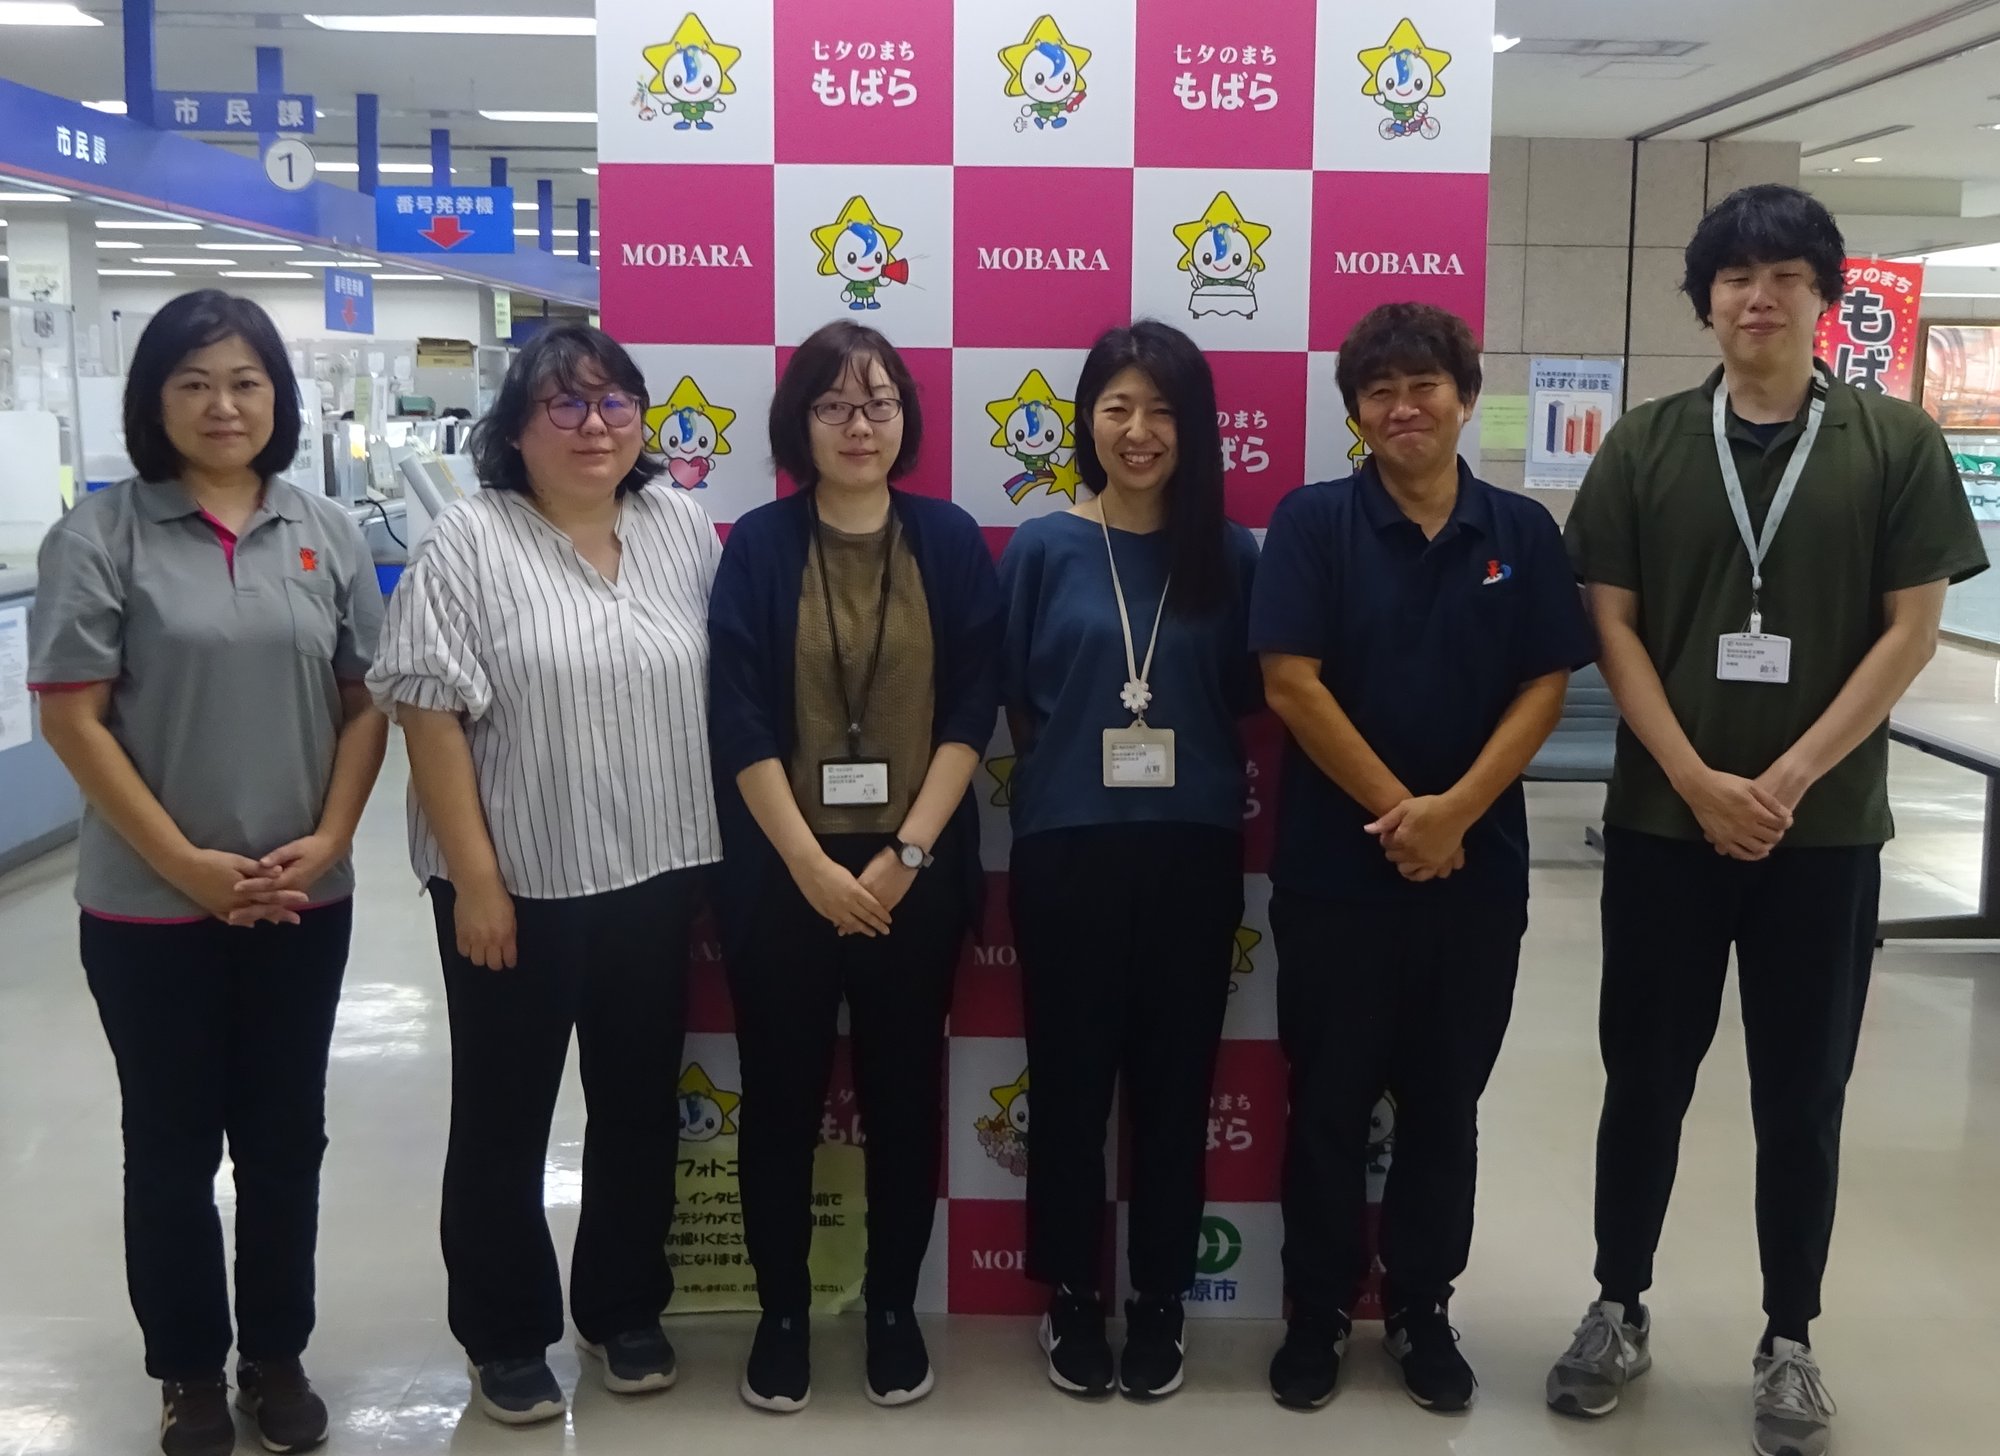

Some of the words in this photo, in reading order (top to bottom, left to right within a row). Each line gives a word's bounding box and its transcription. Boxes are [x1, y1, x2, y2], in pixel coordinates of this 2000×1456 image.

[811, 40, 916, 63] 七夕のまち
[1173, 44, 1278, 66] 七夕のまち
[811, 67, 919, 107] もばら
[1173, 72, 1279, 111] もばら
[174, 98, 304, 127] 市民課
[56, 125, 108, 165] 市民課
[278, 152, 294, 183] 1
[395, 195, 494, 215] 番号発券機
[621, 243, 753, 268] MOBARA
[977, 247, 1110, 272] MOBARA
[1334, 251, 1465, 275] MOBARA
[1187, 1279, 1238, 1302] 原市
